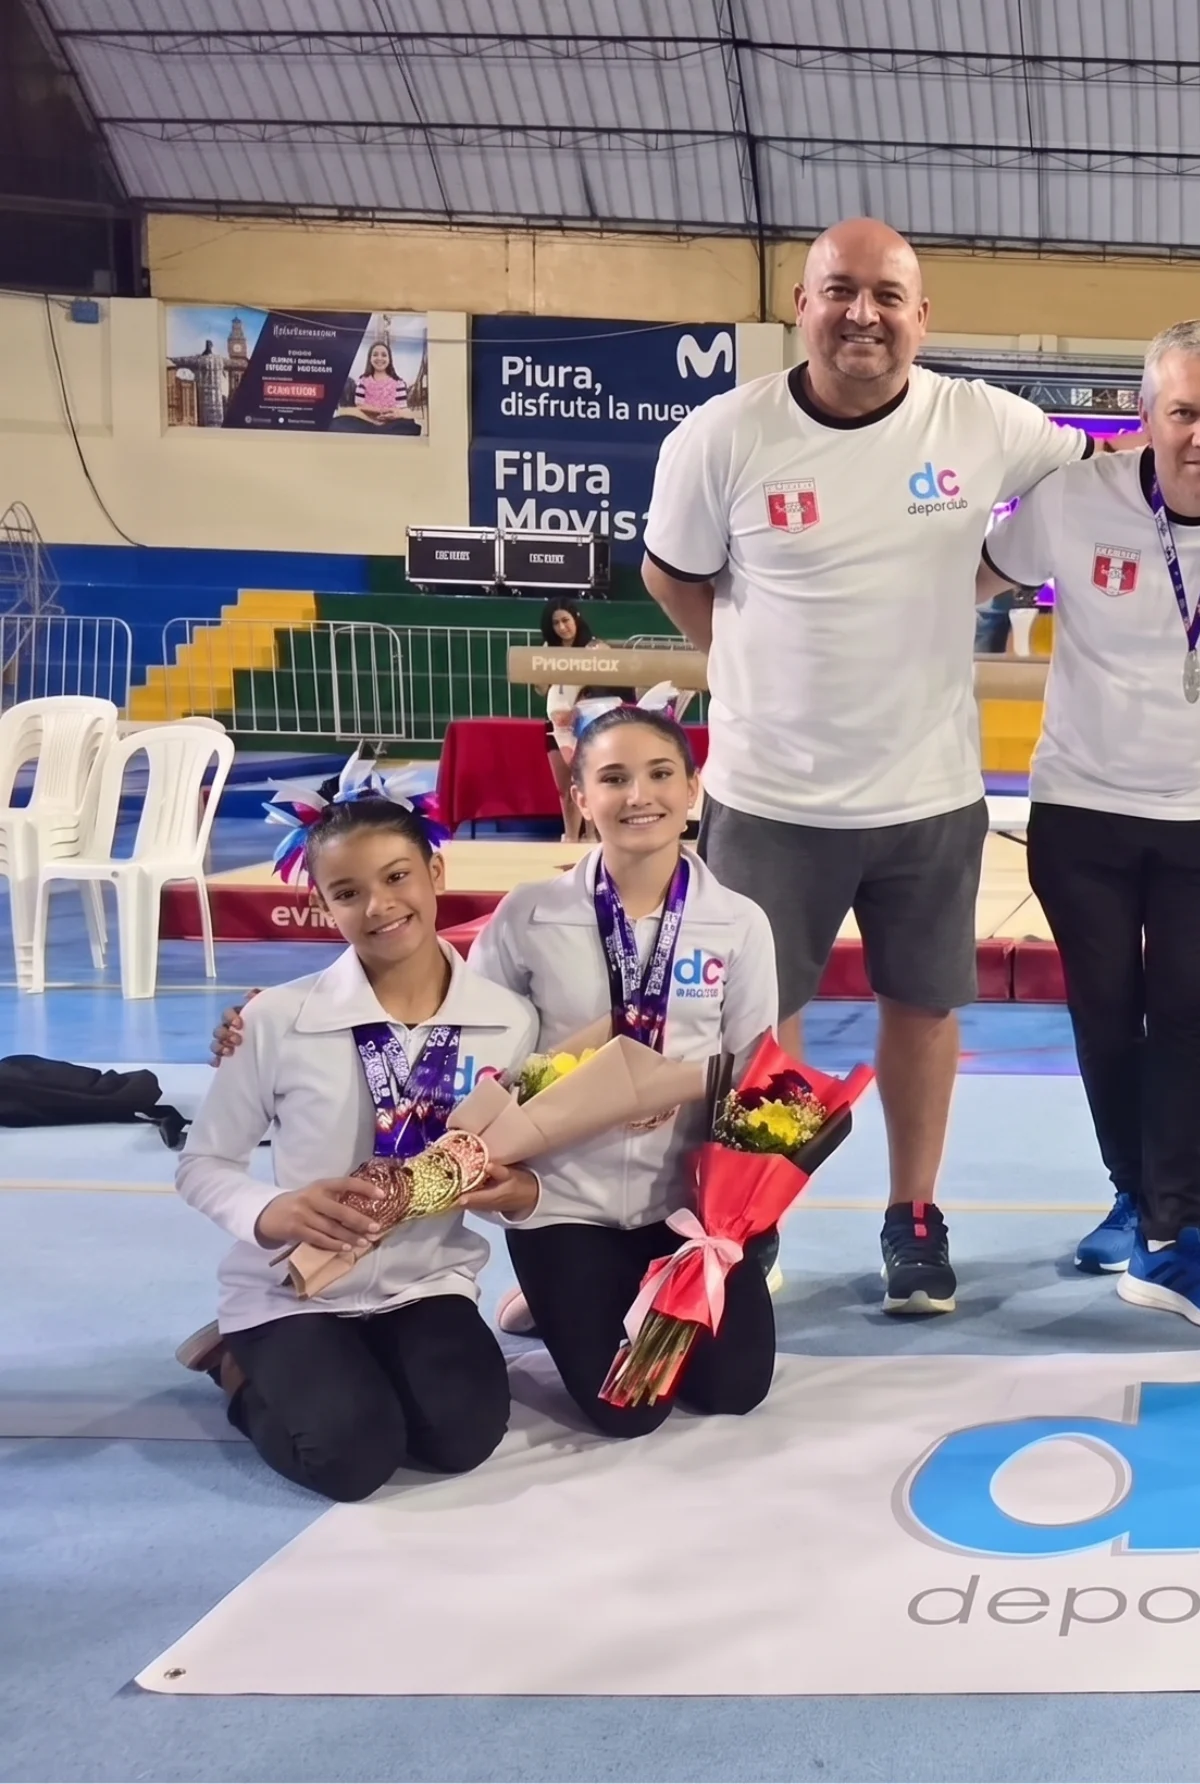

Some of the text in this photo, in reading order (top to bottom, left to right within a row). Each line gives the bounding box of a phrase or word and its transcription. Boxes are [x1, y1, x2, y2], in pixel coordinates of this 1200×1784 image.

[501, 355, 602, 395] Piura,
[500, 391, 601, 419] disfruta
[609, 396, 630, 420] la
[494, 449, 611, 495] Fibra
[909, 462, 960, 499] dc
[496, 496, 650, 541] Movis
[673, 948, 724, 985] dc
